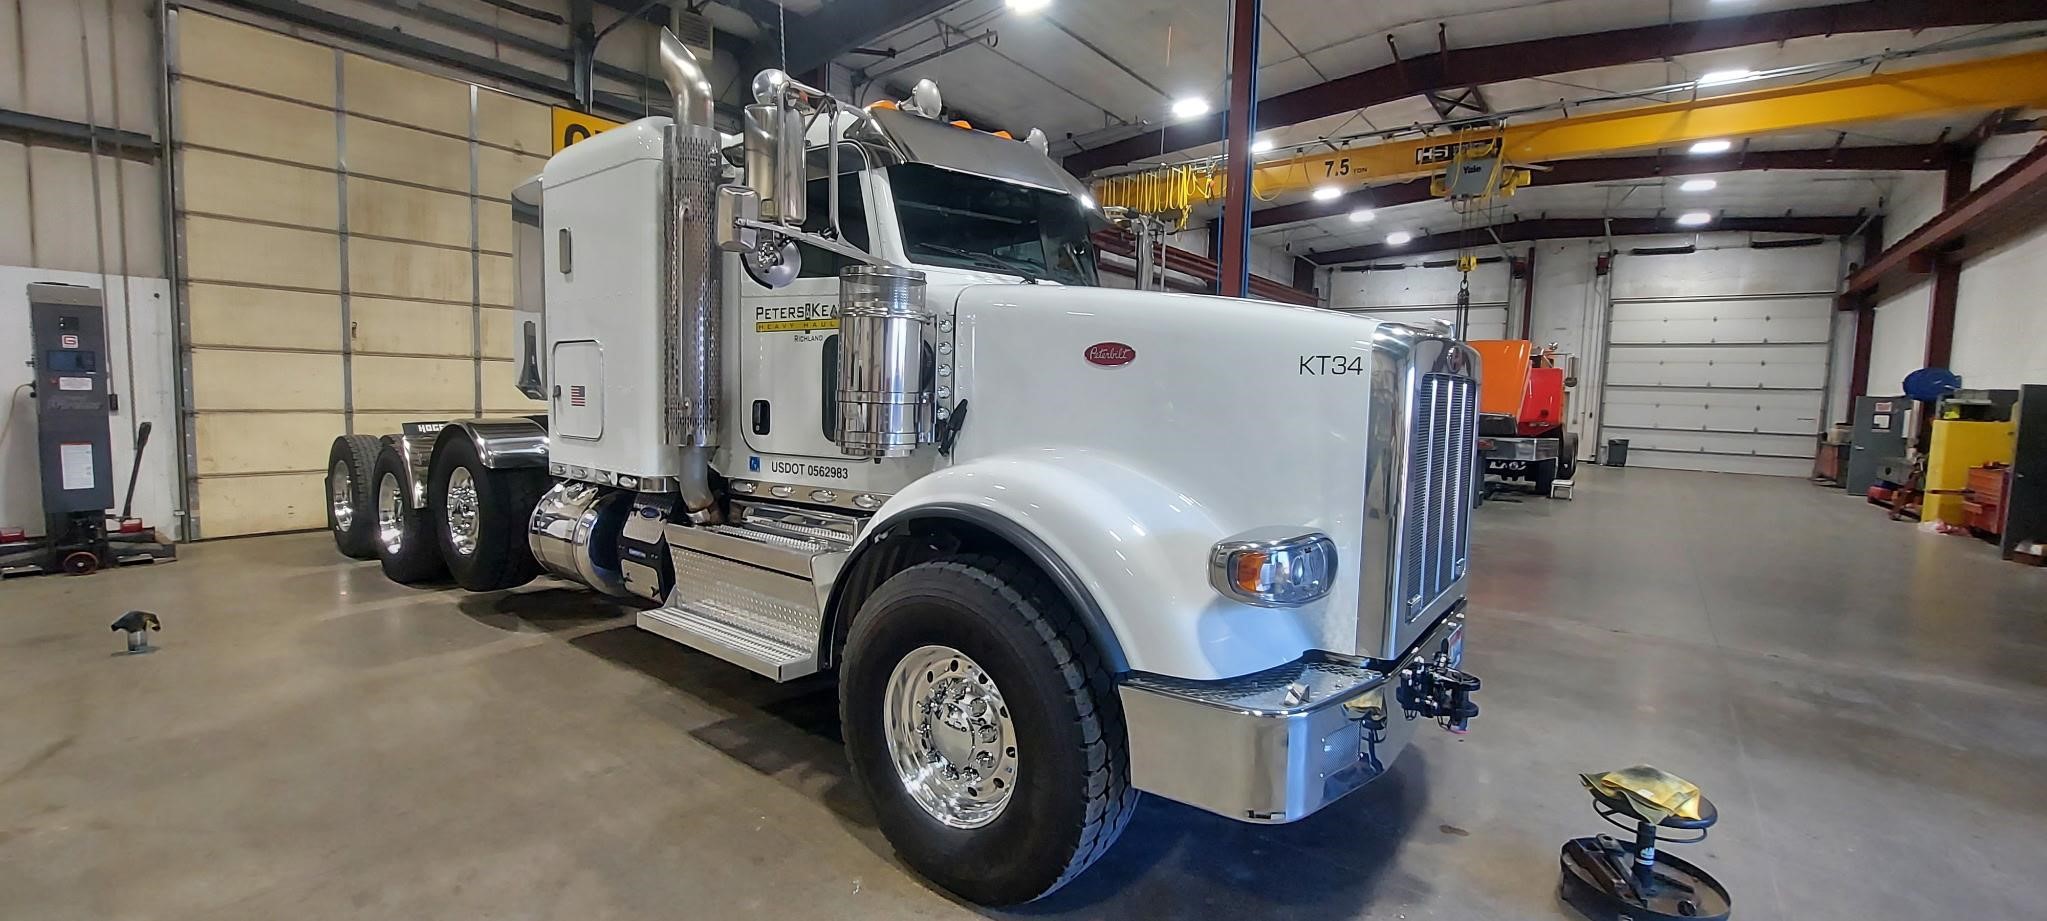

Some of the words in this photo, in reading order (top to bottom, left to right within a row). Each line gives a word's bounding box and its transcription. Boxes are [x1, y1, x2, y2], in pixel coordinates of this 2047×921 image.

[1324, 159, 1349, 177] 7.5
[1463, 165, 1481, 174] Yale
[756, 306, 804, 320] PETERS
[812, 303, 840, 318] KEA
[803, 321, 835, 329] HAUL
[794, 335, 823, 343] RICHLAND
[1090, 346, 1131, 360] Peterbilt
[1299, 355, 1363, 375] KT34
[771, 461, 805, 475] USDOT
[808, 465, 848, 479] 0562983
